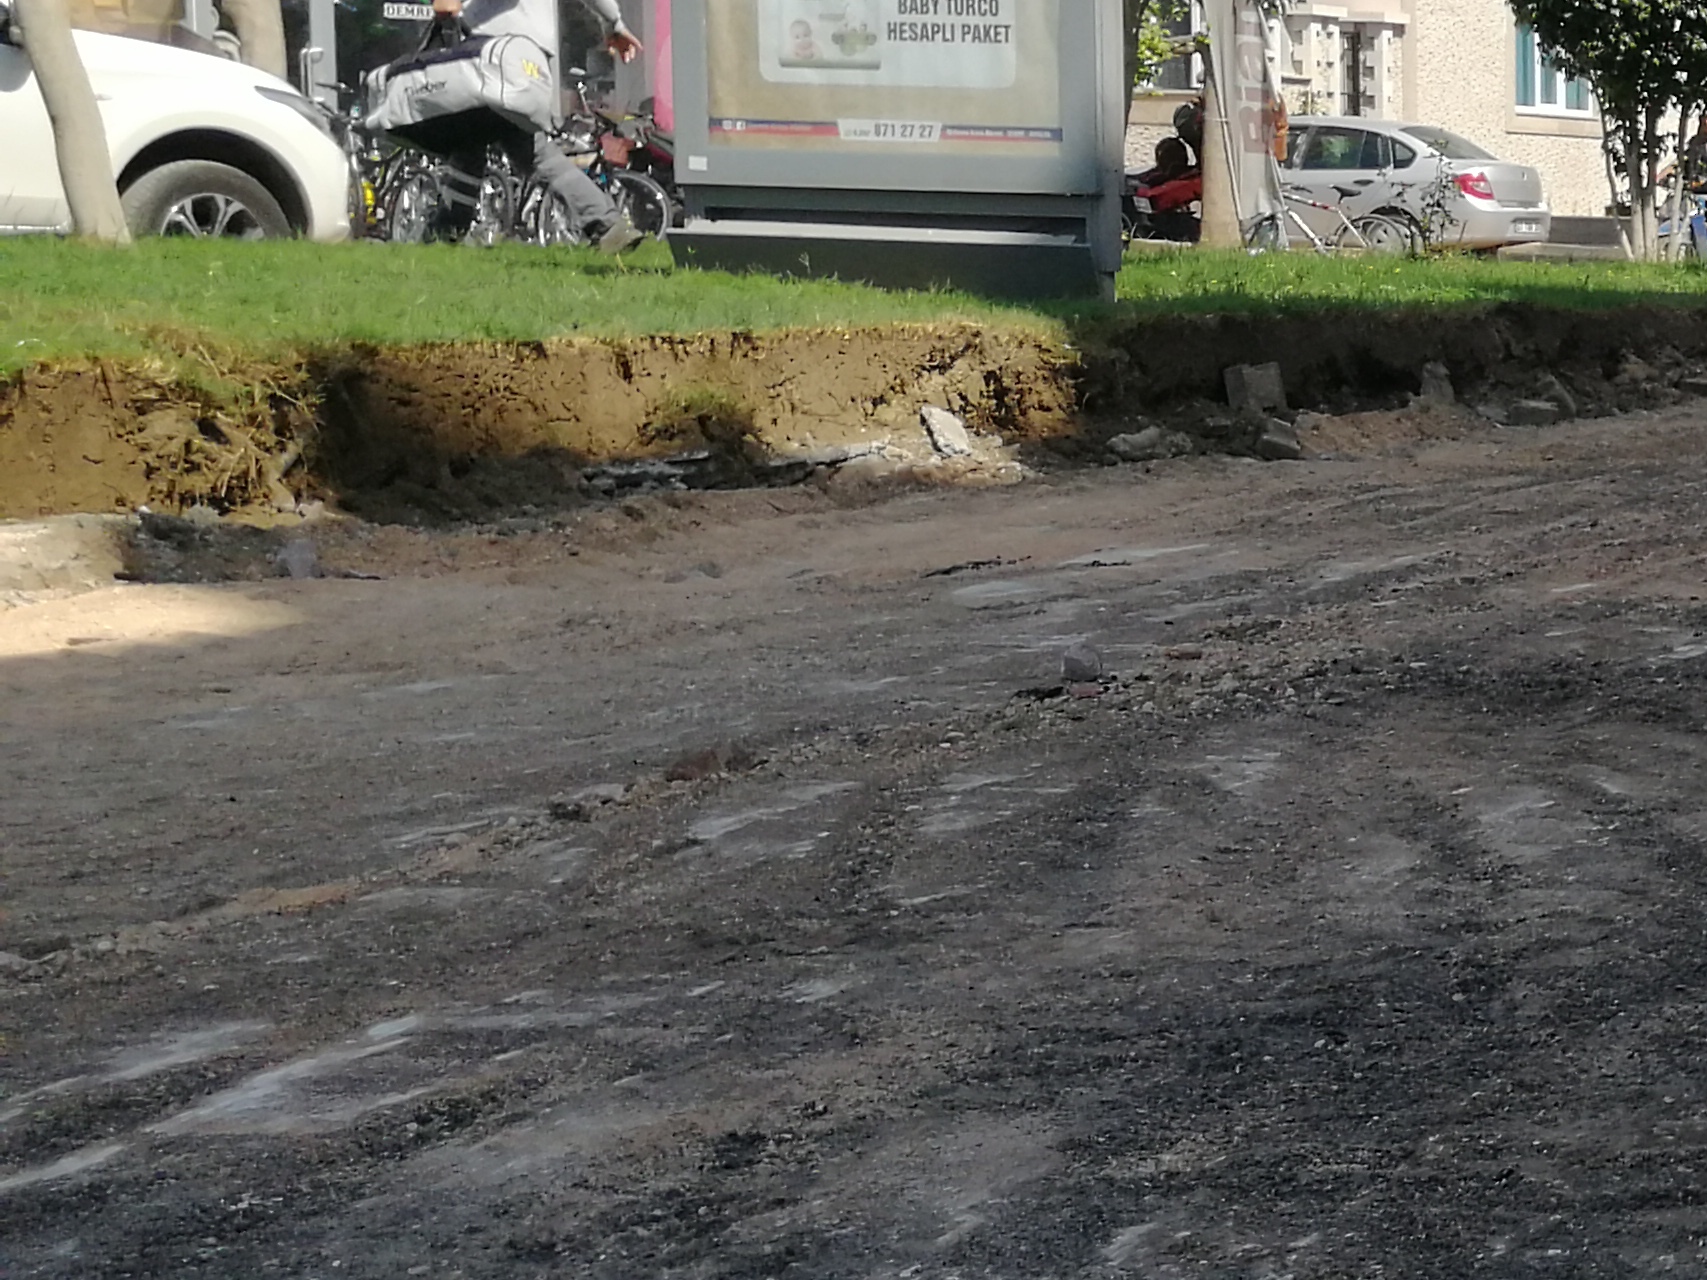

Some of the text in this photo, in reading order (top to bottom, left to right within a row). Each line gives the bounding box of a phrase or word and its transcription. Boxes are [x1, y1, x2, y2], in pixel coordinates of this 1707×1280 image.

[886, 21, 1012, 44] HESAPLI PAKET
[900, 124, 915, 138] 27
[918, 124, 934, 138] 27
